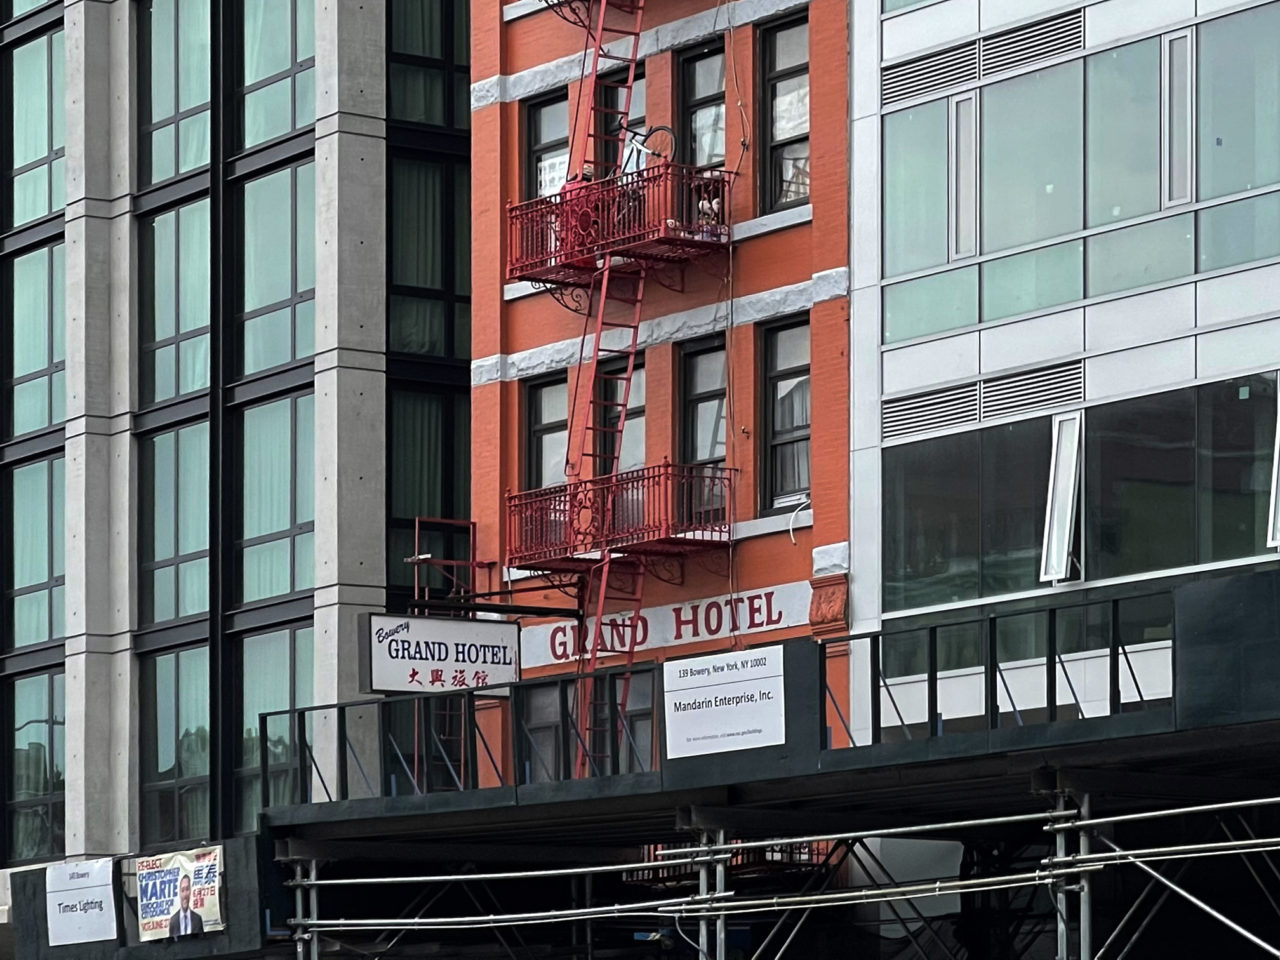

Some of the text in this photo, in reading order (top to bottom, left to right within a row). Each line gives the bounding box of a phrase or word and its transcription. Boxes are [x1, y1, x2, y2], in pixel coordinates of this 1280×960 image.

[673, 591, 783, 640] HOTEL
[375, 621, 410, 644] Bowery
[388, 639, 512, 666] GRAND HOTEL
[678, 657, 767, 678] 139 Bowery, New York, NY 10002
[673, 690, 774, 713] Mandarin Enterprise, Inc.
[140, 878, 178, 902] MARTE
[57, 898, 104, 914] Times Lighting
